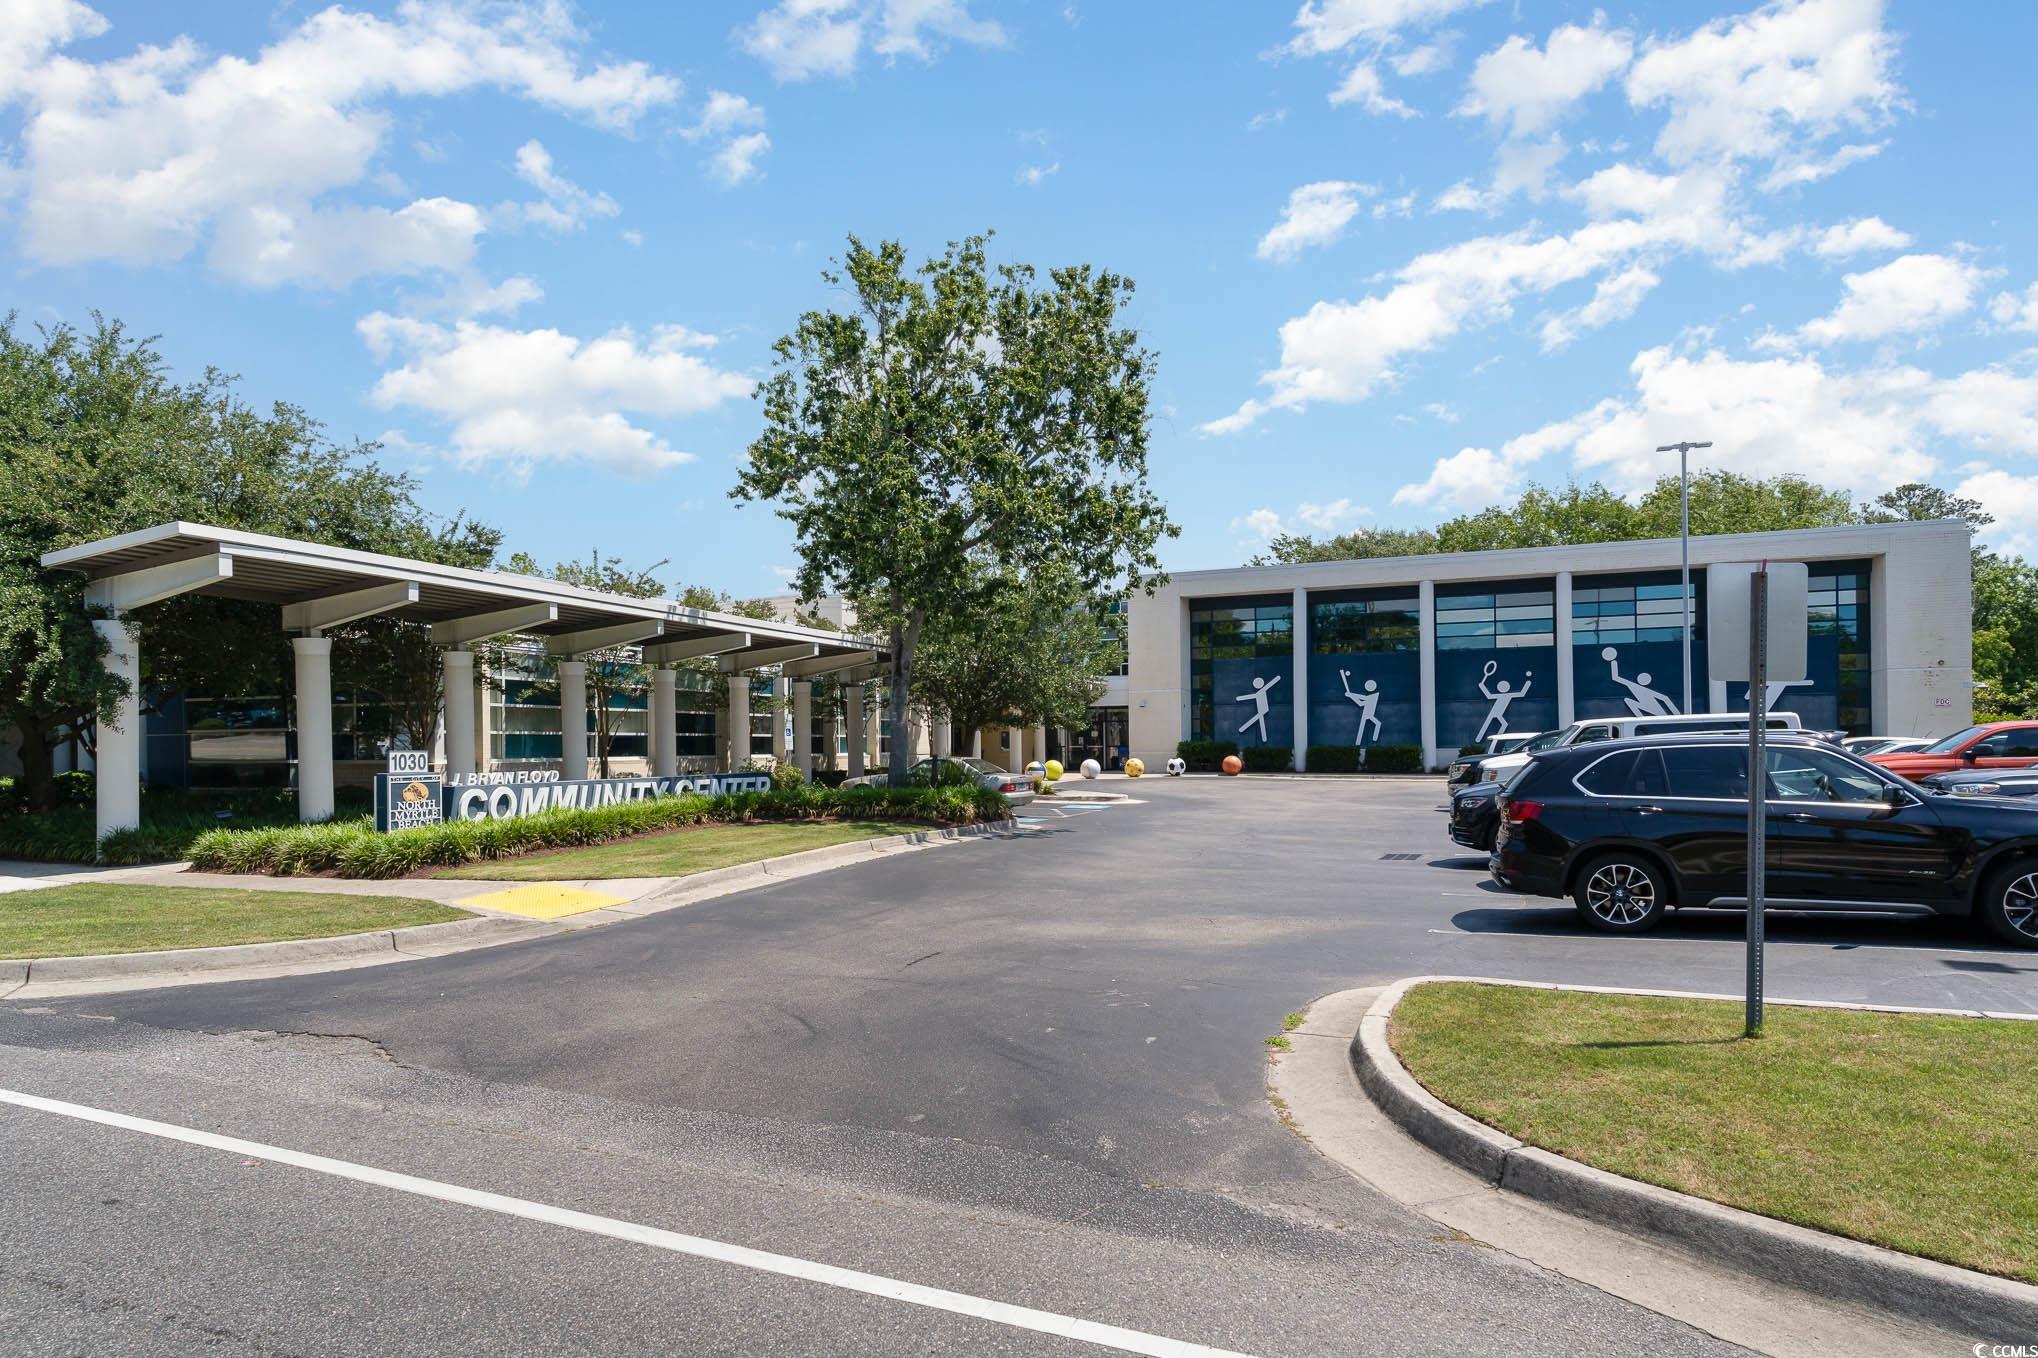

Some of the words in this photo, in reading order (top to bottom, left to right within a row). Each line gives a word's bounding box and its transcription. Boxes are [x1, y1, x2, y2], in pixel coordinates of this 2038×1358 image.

[391, 753, 427, 771] 1030
[467, 771, 515, 786] BRYAN
[517, 769, 560, 784] FLOYD
[396, 800, 436, 811] NORTH
[459, 780, 671, 823] COMMUNITY
[674, 776, 771, 797] CENTER
[395, 808, 440, 821] MYRTLE
[398, 818, 434, 830] BEACH
